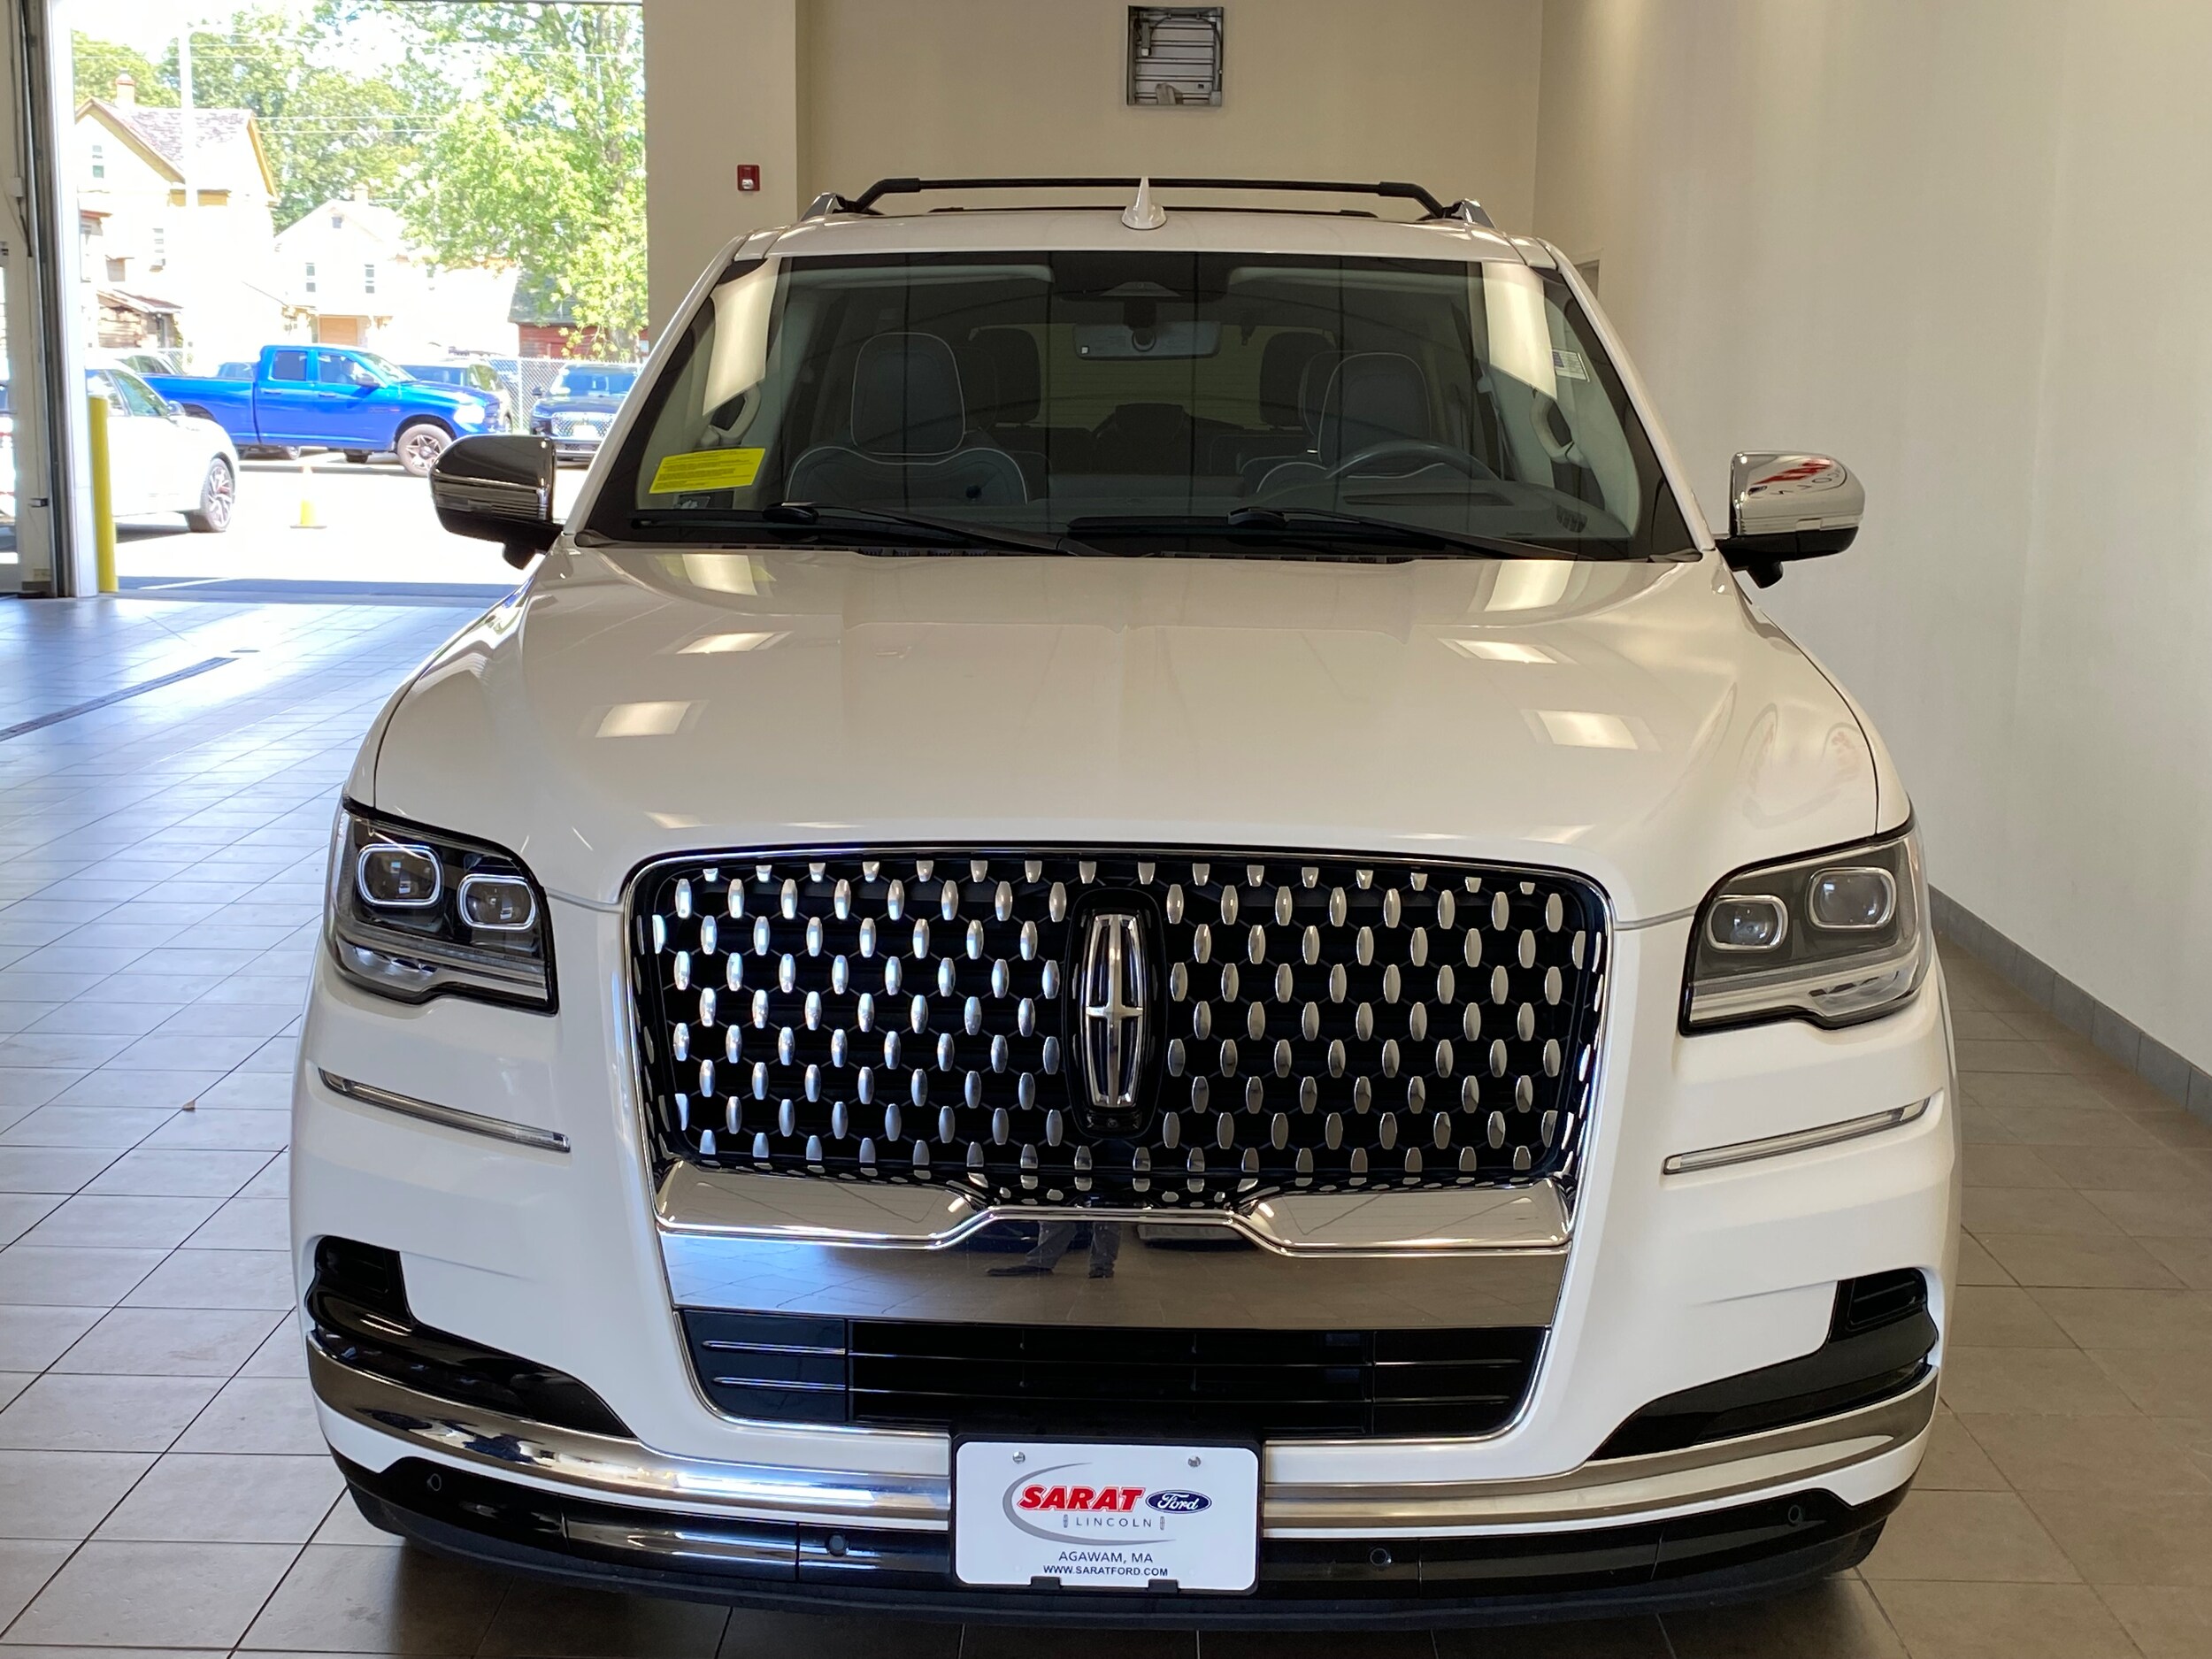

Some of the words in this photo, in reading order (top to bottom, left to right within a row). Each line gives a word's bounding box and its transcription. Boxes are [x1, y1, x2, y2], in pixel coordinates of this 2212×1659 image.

[1017, 1485, 1146, 1512] SARAT
[1157, 1492, 1199, 1510] Ford
[1075, 1517, 1152, 1528] LINCOLN
[1058, 1551, 1127, 1564] AGAWAM,
[1131, 1553, 1153, 1563] MA
[1043, 1565, 1168, 1577] WWW.SARATFORD.COM
